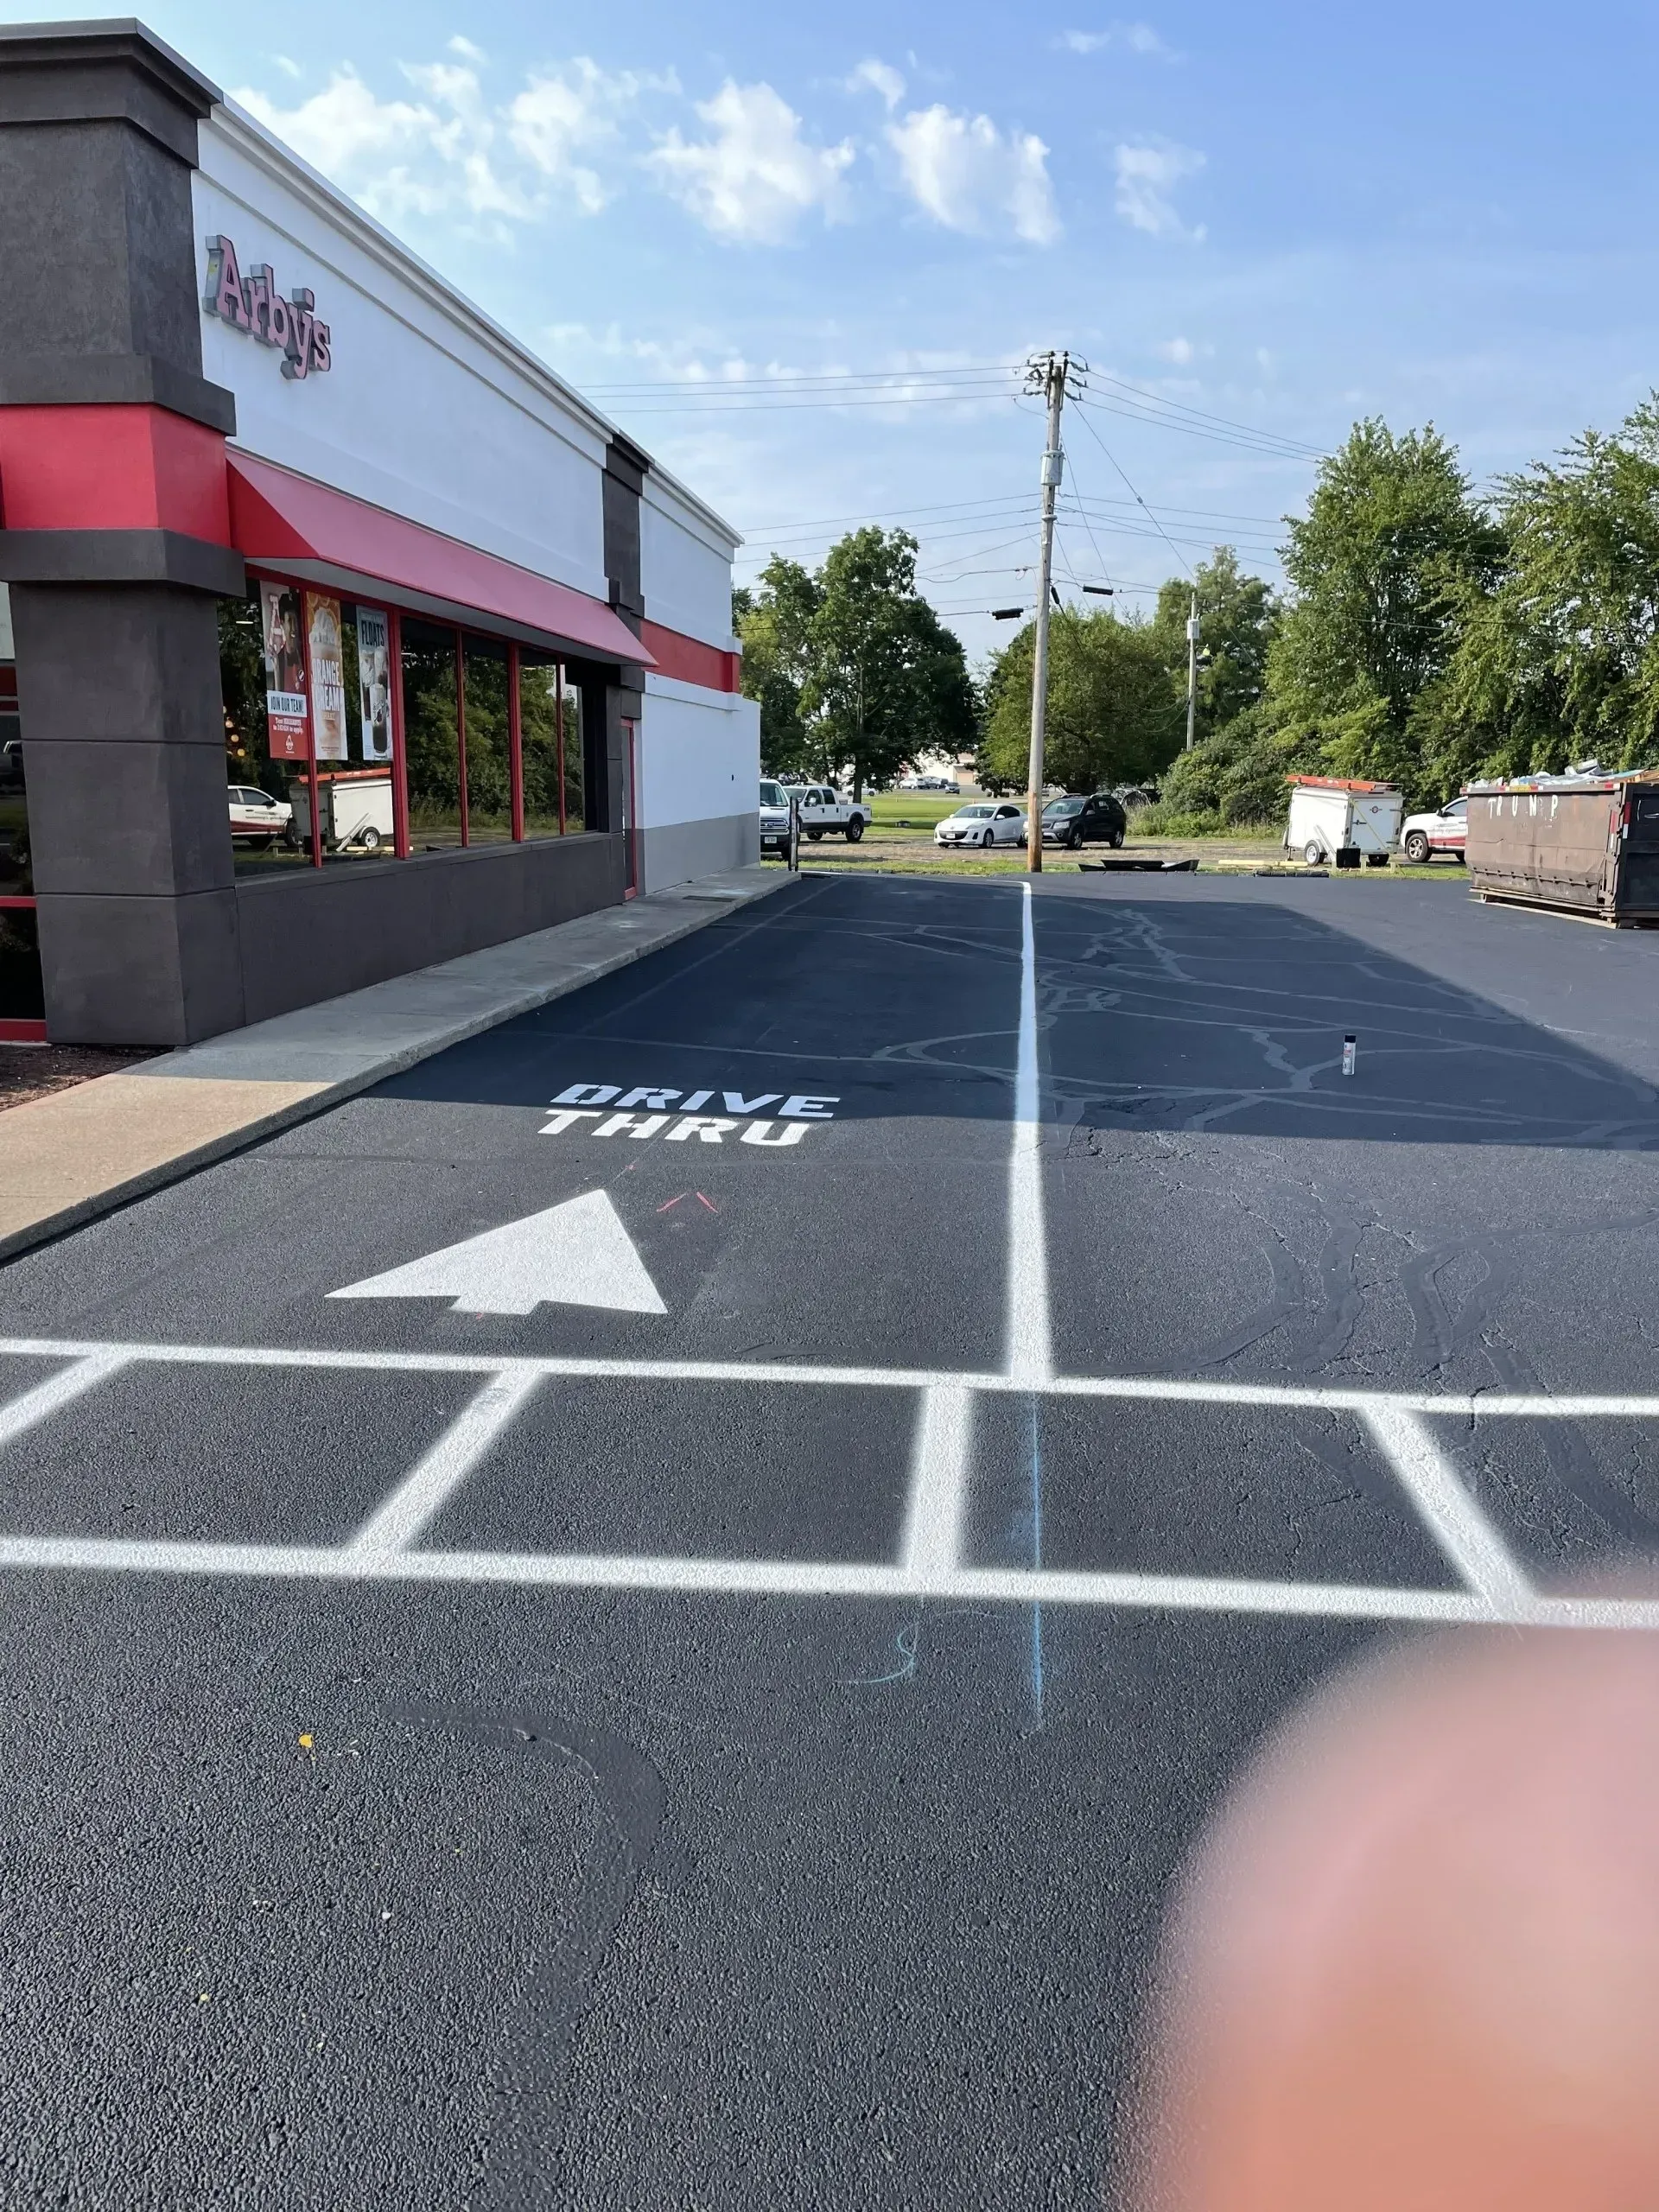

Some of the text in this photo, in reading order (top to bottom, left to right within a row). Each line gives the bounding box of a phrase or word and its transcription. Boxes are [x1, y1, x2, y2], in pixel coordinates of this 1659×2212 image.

[207, 234, 331, 379] Arby's
[361, 620, 385, 647] FLOATS
[550, 1083, 842, 1119] DRIVE
[537, 1109, 810, 1147] THRU
